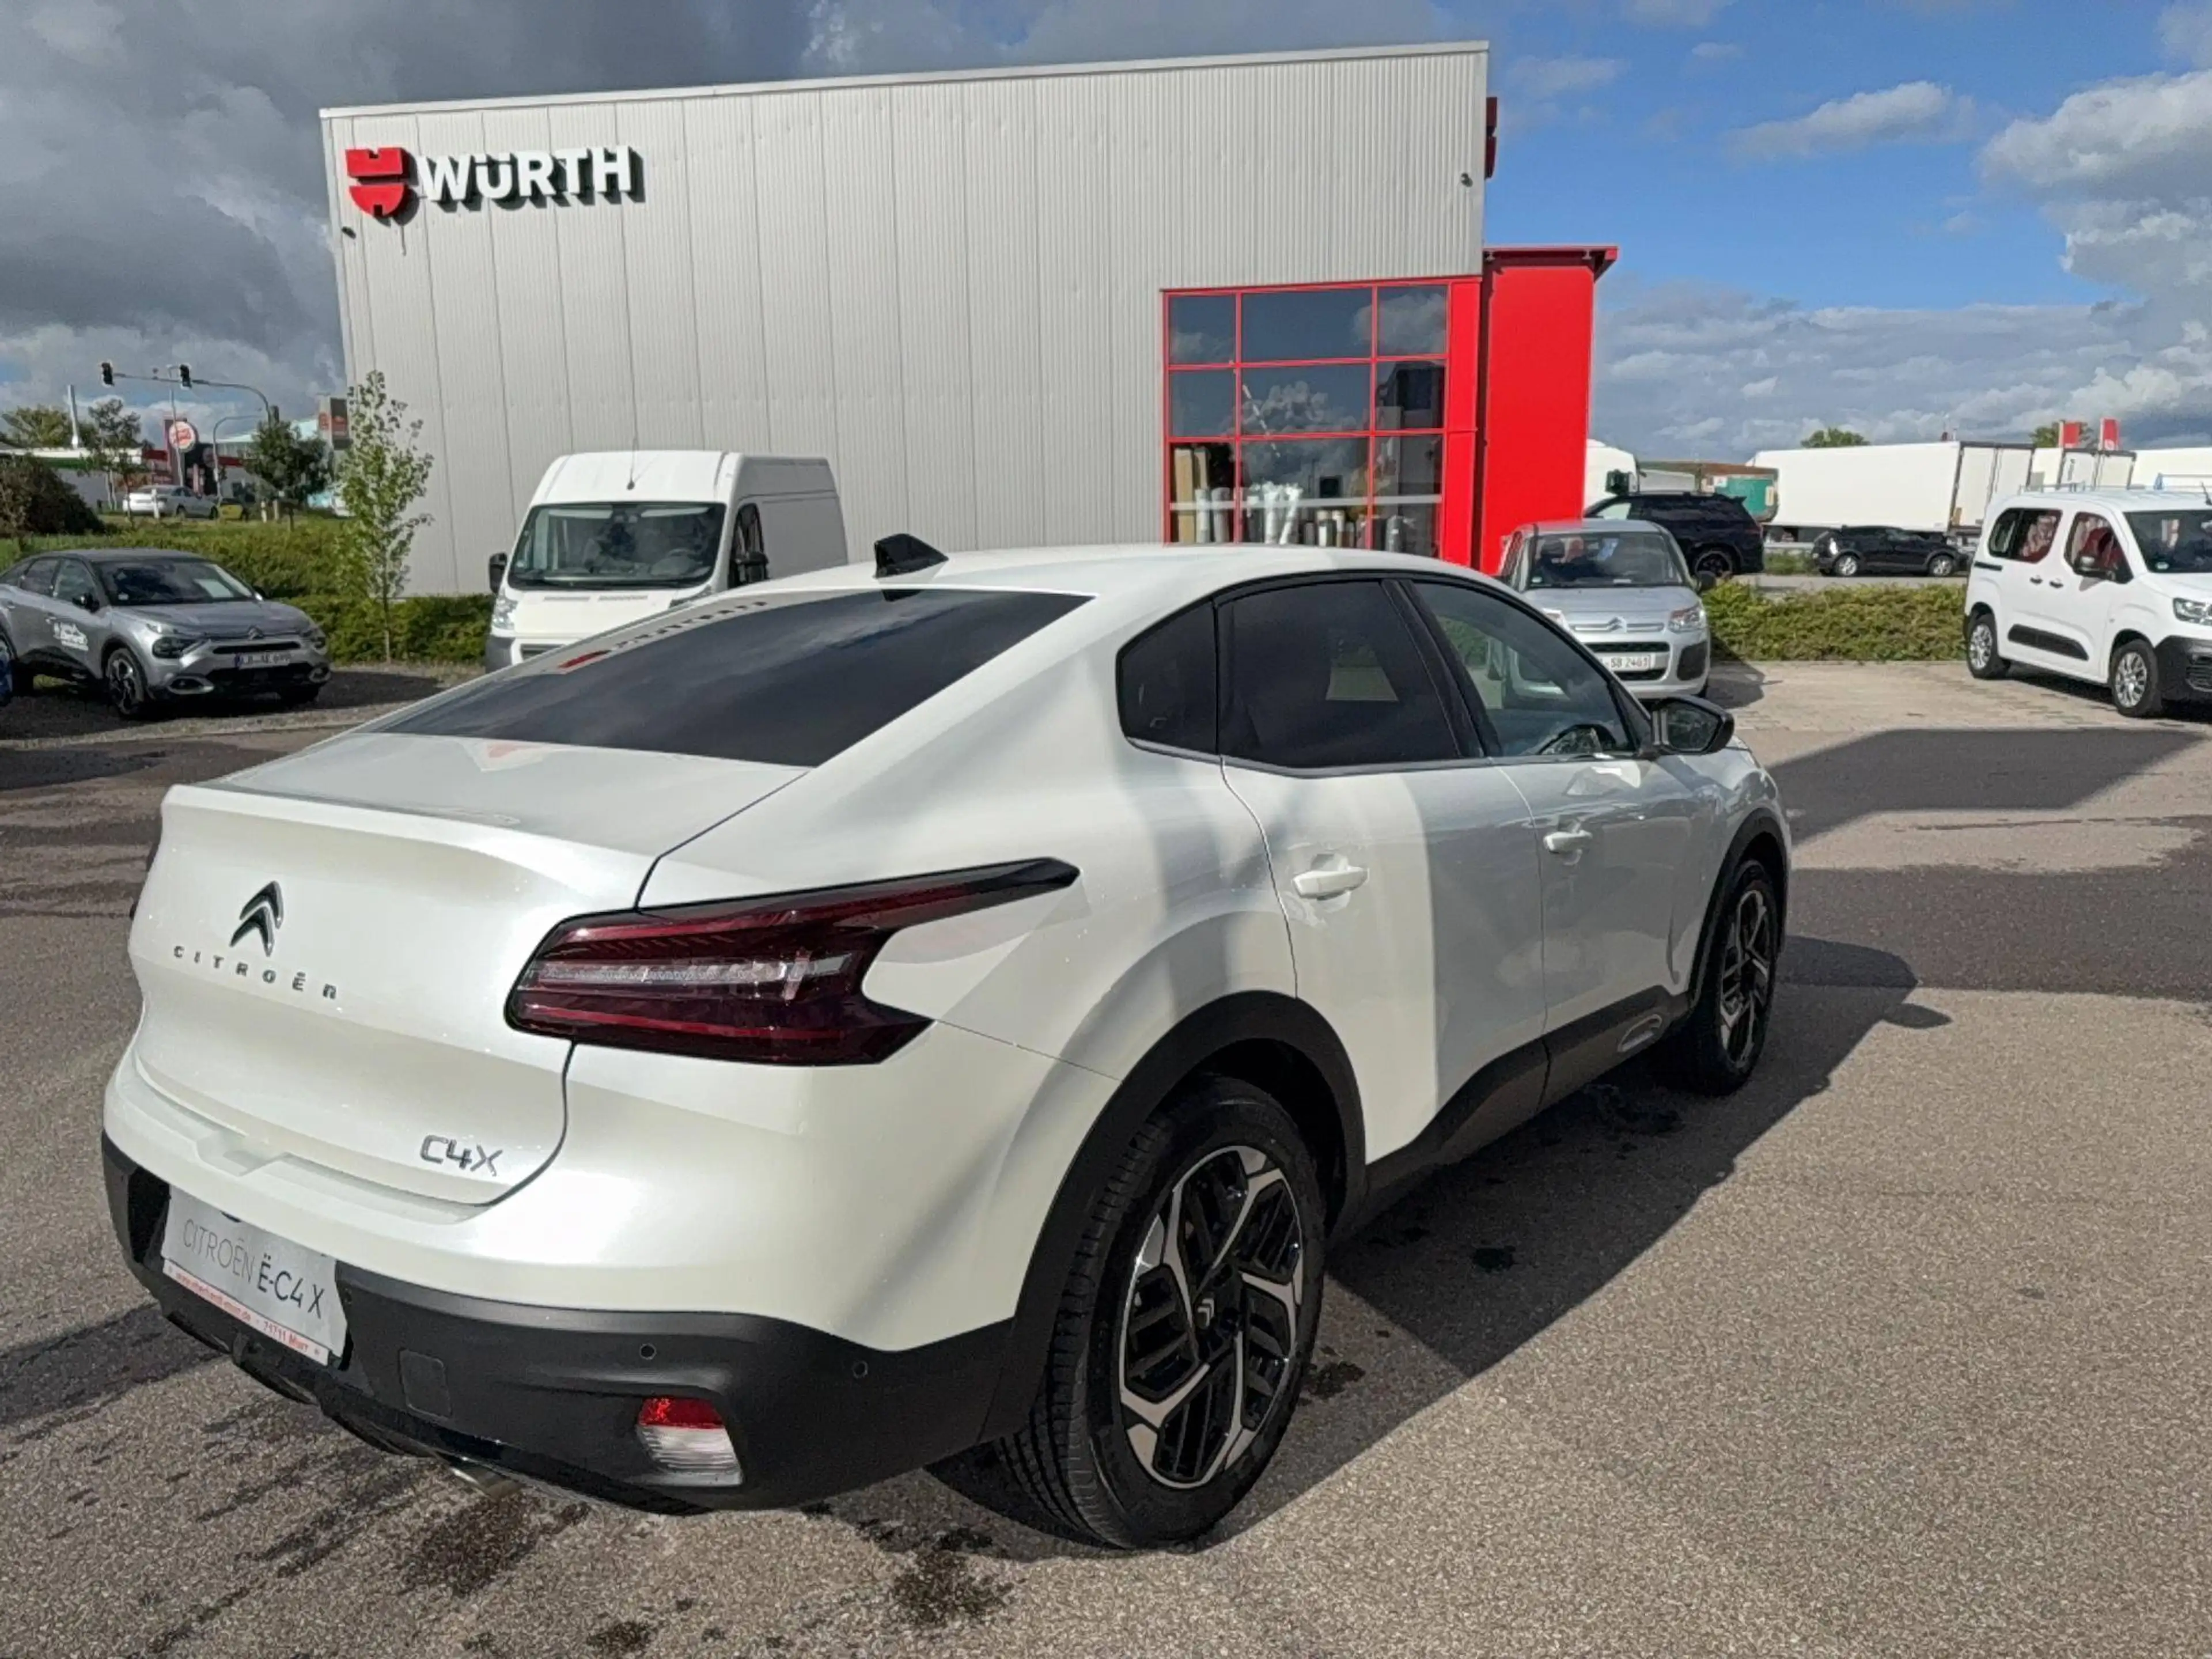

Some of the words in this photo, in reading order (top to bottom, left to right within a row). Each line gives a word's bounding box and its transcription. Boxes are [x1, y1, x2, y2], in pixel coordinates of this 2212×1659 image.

[417, 145, 637, 205] WÜRTH
[173, 945, 339, 1001] CITROËN
[182, 1218, 256, 1284] CITROËN
[257, 1253, 304, 1309] Ë-C4
[308, 1283, 326, 1320] X
